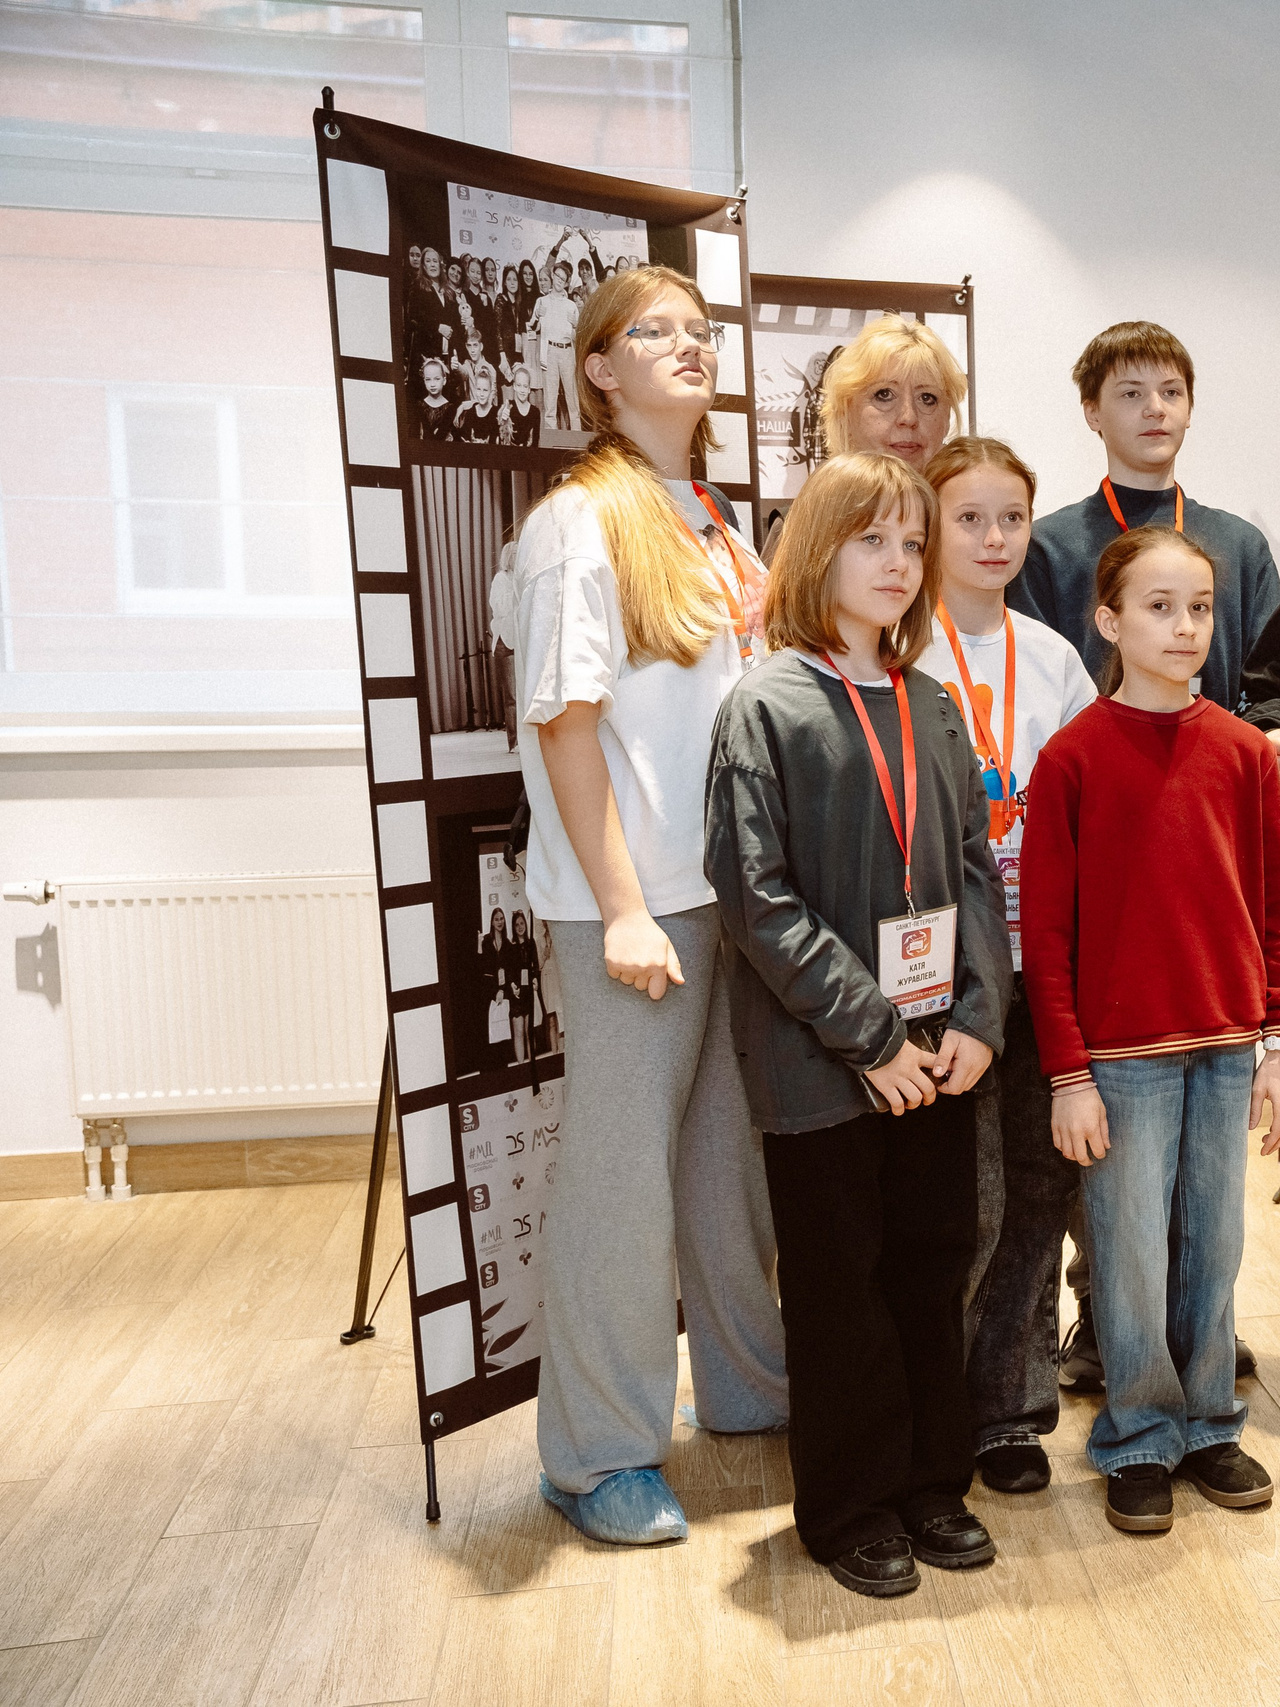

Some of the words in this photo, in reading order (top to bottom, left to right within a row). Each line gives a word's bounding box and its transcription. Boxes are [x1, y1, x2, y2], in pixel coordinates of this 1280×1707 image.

[757, 420, 794, 433] НАША
[895, 915, 941, 931] САНКТ-ПЕТЕРБУРГ
[909, 961, 926, 973] КАТЯ
[896, 969, 937, 988] ЖУРАВЛЕВА
